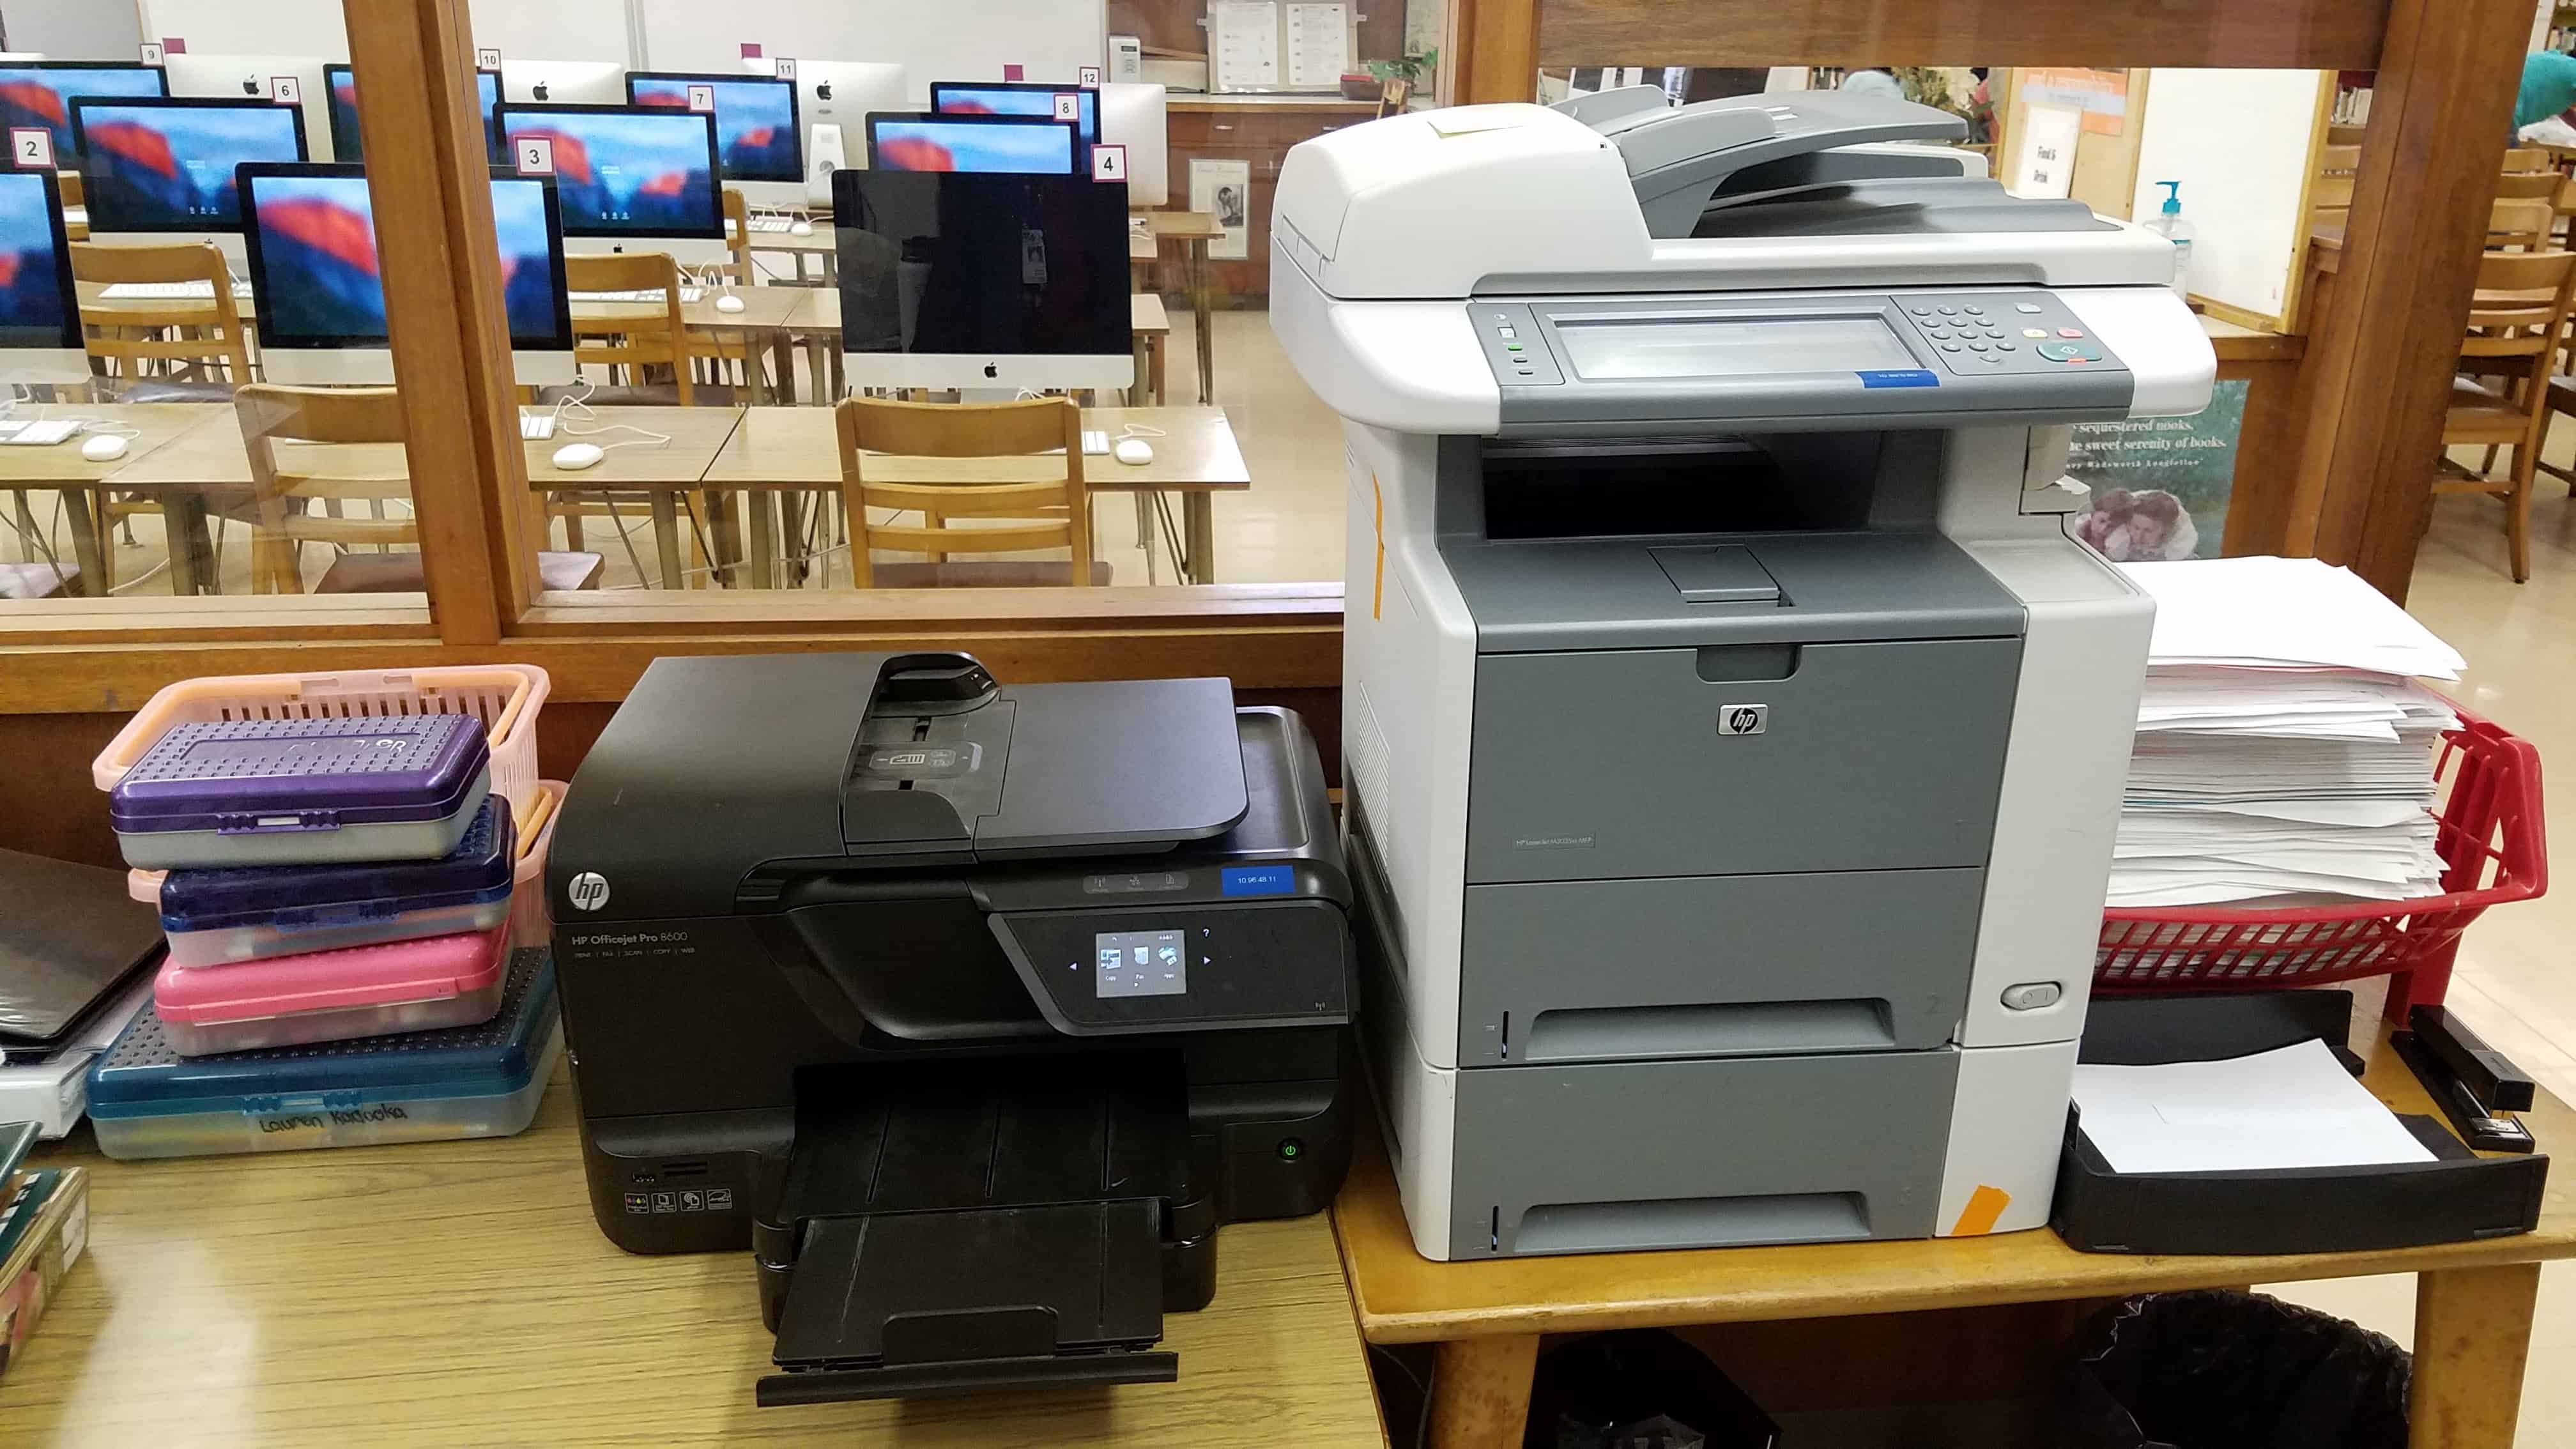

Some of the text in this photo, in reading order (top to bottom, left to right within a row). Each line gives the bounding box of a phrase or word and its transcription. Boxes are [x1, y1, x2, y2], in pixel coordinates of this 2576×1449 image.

[148, 50, 155, 59] 9
[484, 55, 496, 65] 10
[780, 65, 792, 74] 11
[1084, 73, 1096, 82] 12
[281, 84, 289, 97] 6
[696, 94, 704, 105] 7
[1062, 102, 1070, 114] 8
[26, 141, 38, 157] 2
[529, 149, 540, 165] 3
[1103, 157, 1114, 172] 4
[2085, 439, 2120, 450] sweet
[2124, 437, 2171, 450] serenity
[2175, 436, 2189, 448] of
[1731, 707, 1757, 734] hp
[573, 871, 606, 910] hp
[572, 931, 688, 946] HP Officejet Pro 8600
[259, 1116, 325, 1133] Lauren
